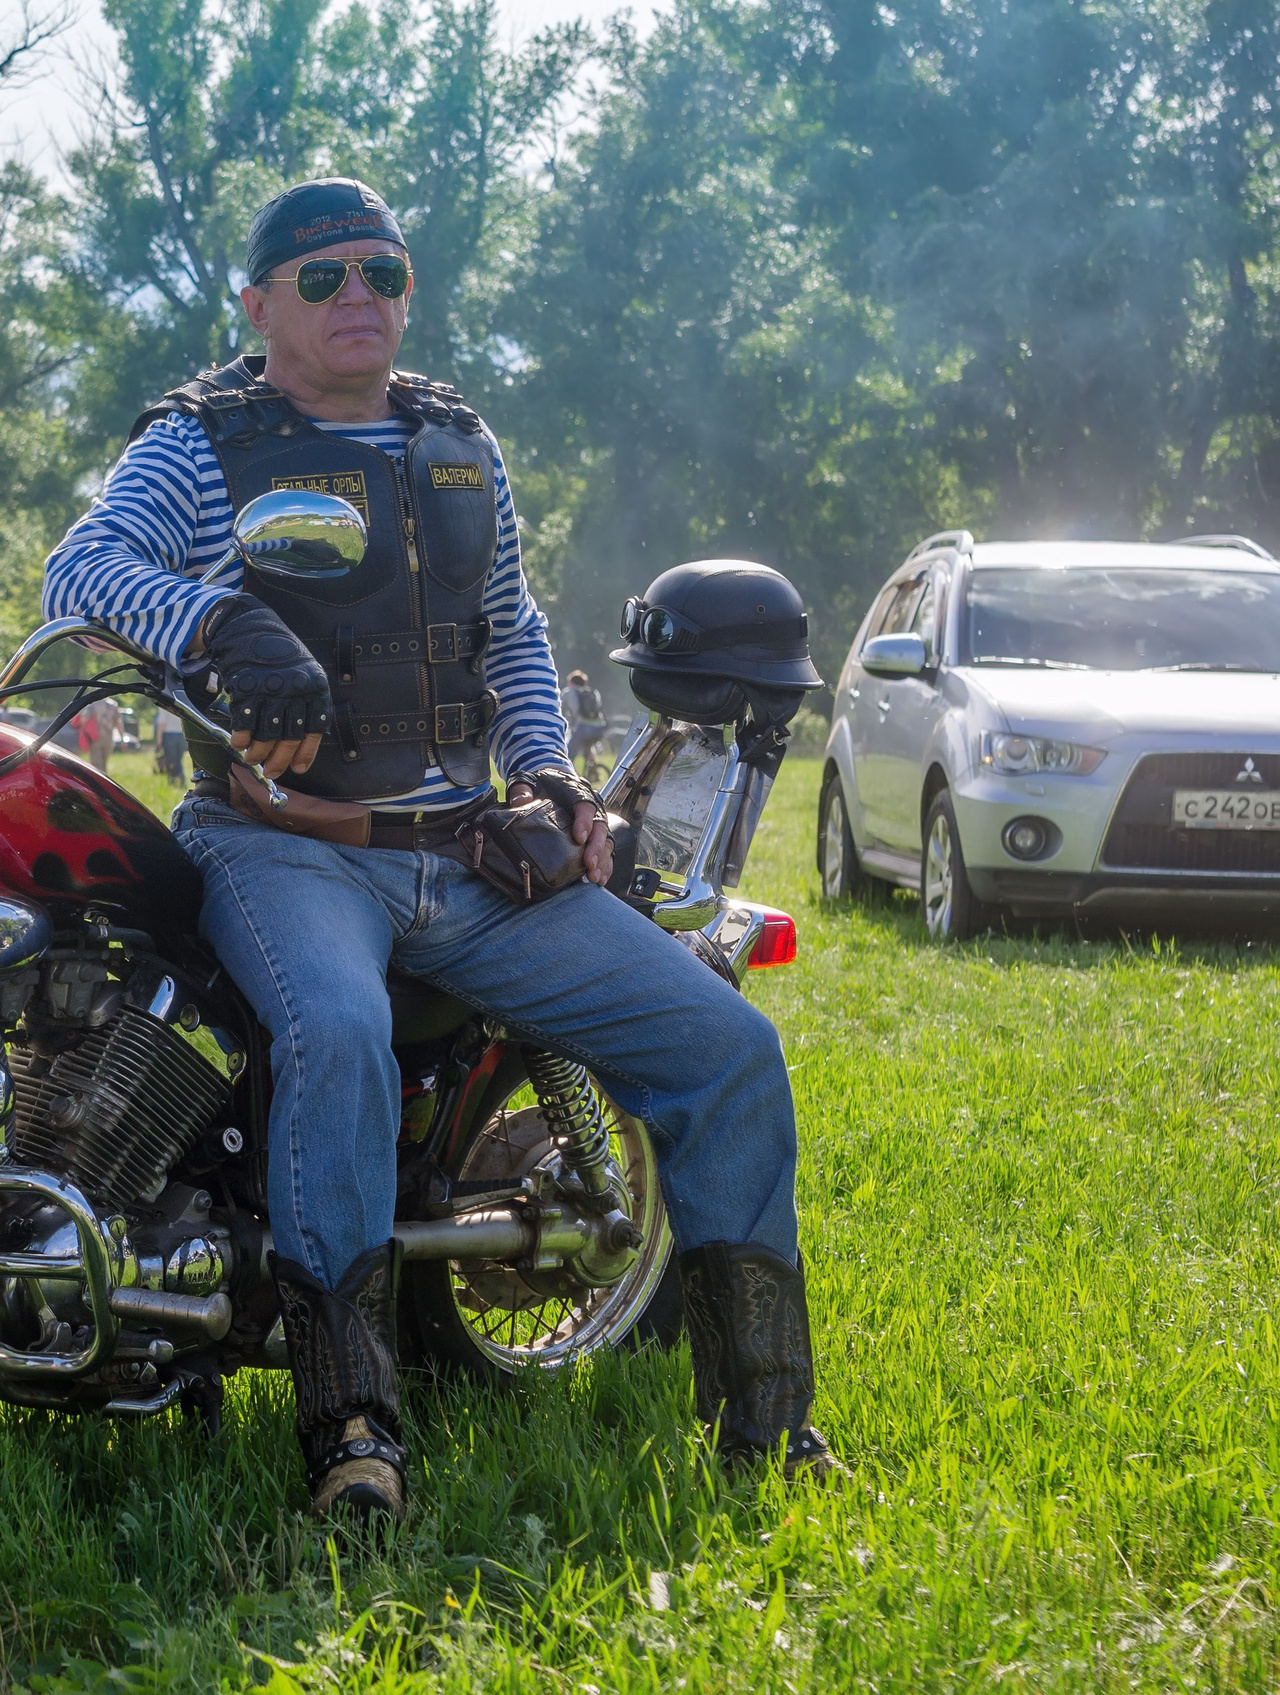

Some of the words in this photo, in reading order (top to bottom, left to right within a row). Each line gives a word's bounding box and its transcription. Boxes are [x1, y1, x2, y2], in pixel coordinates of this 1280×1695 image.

[310, 215, 331, 226] 2012
[346, 210, 364, 218] 71st
[293, 222, 333, 244] BIKE
[306, 228, 343, 243] Daytona
[348, 224, 375, 233] Beach
[332, 476, 362, 494] ОРЛЫ
[433, 466, 482, 486] ВАЛЕРИЙ
